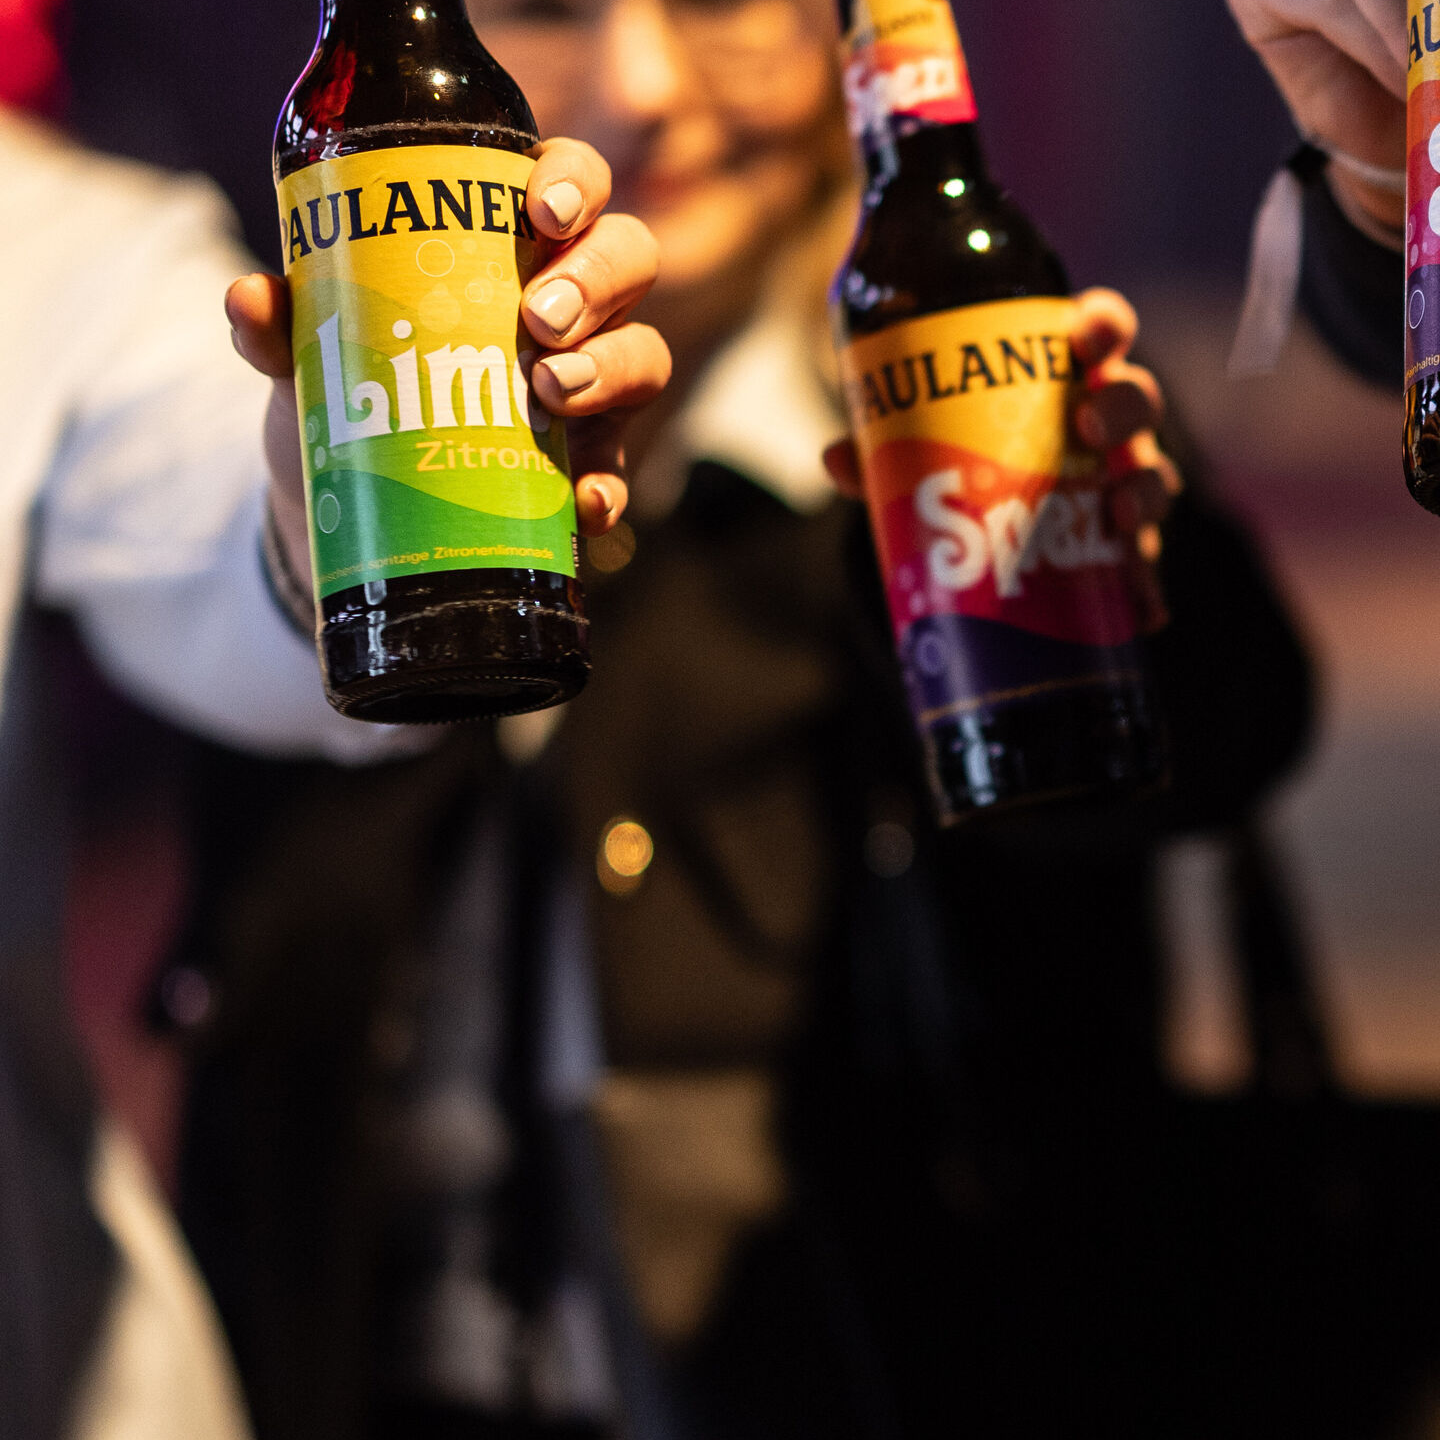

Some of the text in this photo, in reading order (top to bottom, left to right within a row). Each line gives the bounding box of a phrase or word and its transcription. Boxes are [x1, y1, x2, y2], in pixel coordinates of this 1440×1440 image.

[283, 179, 537, 264] AULANER
[863, 335, 1071, 417] AULANE
[916, 468, 1122, 598] Spez
